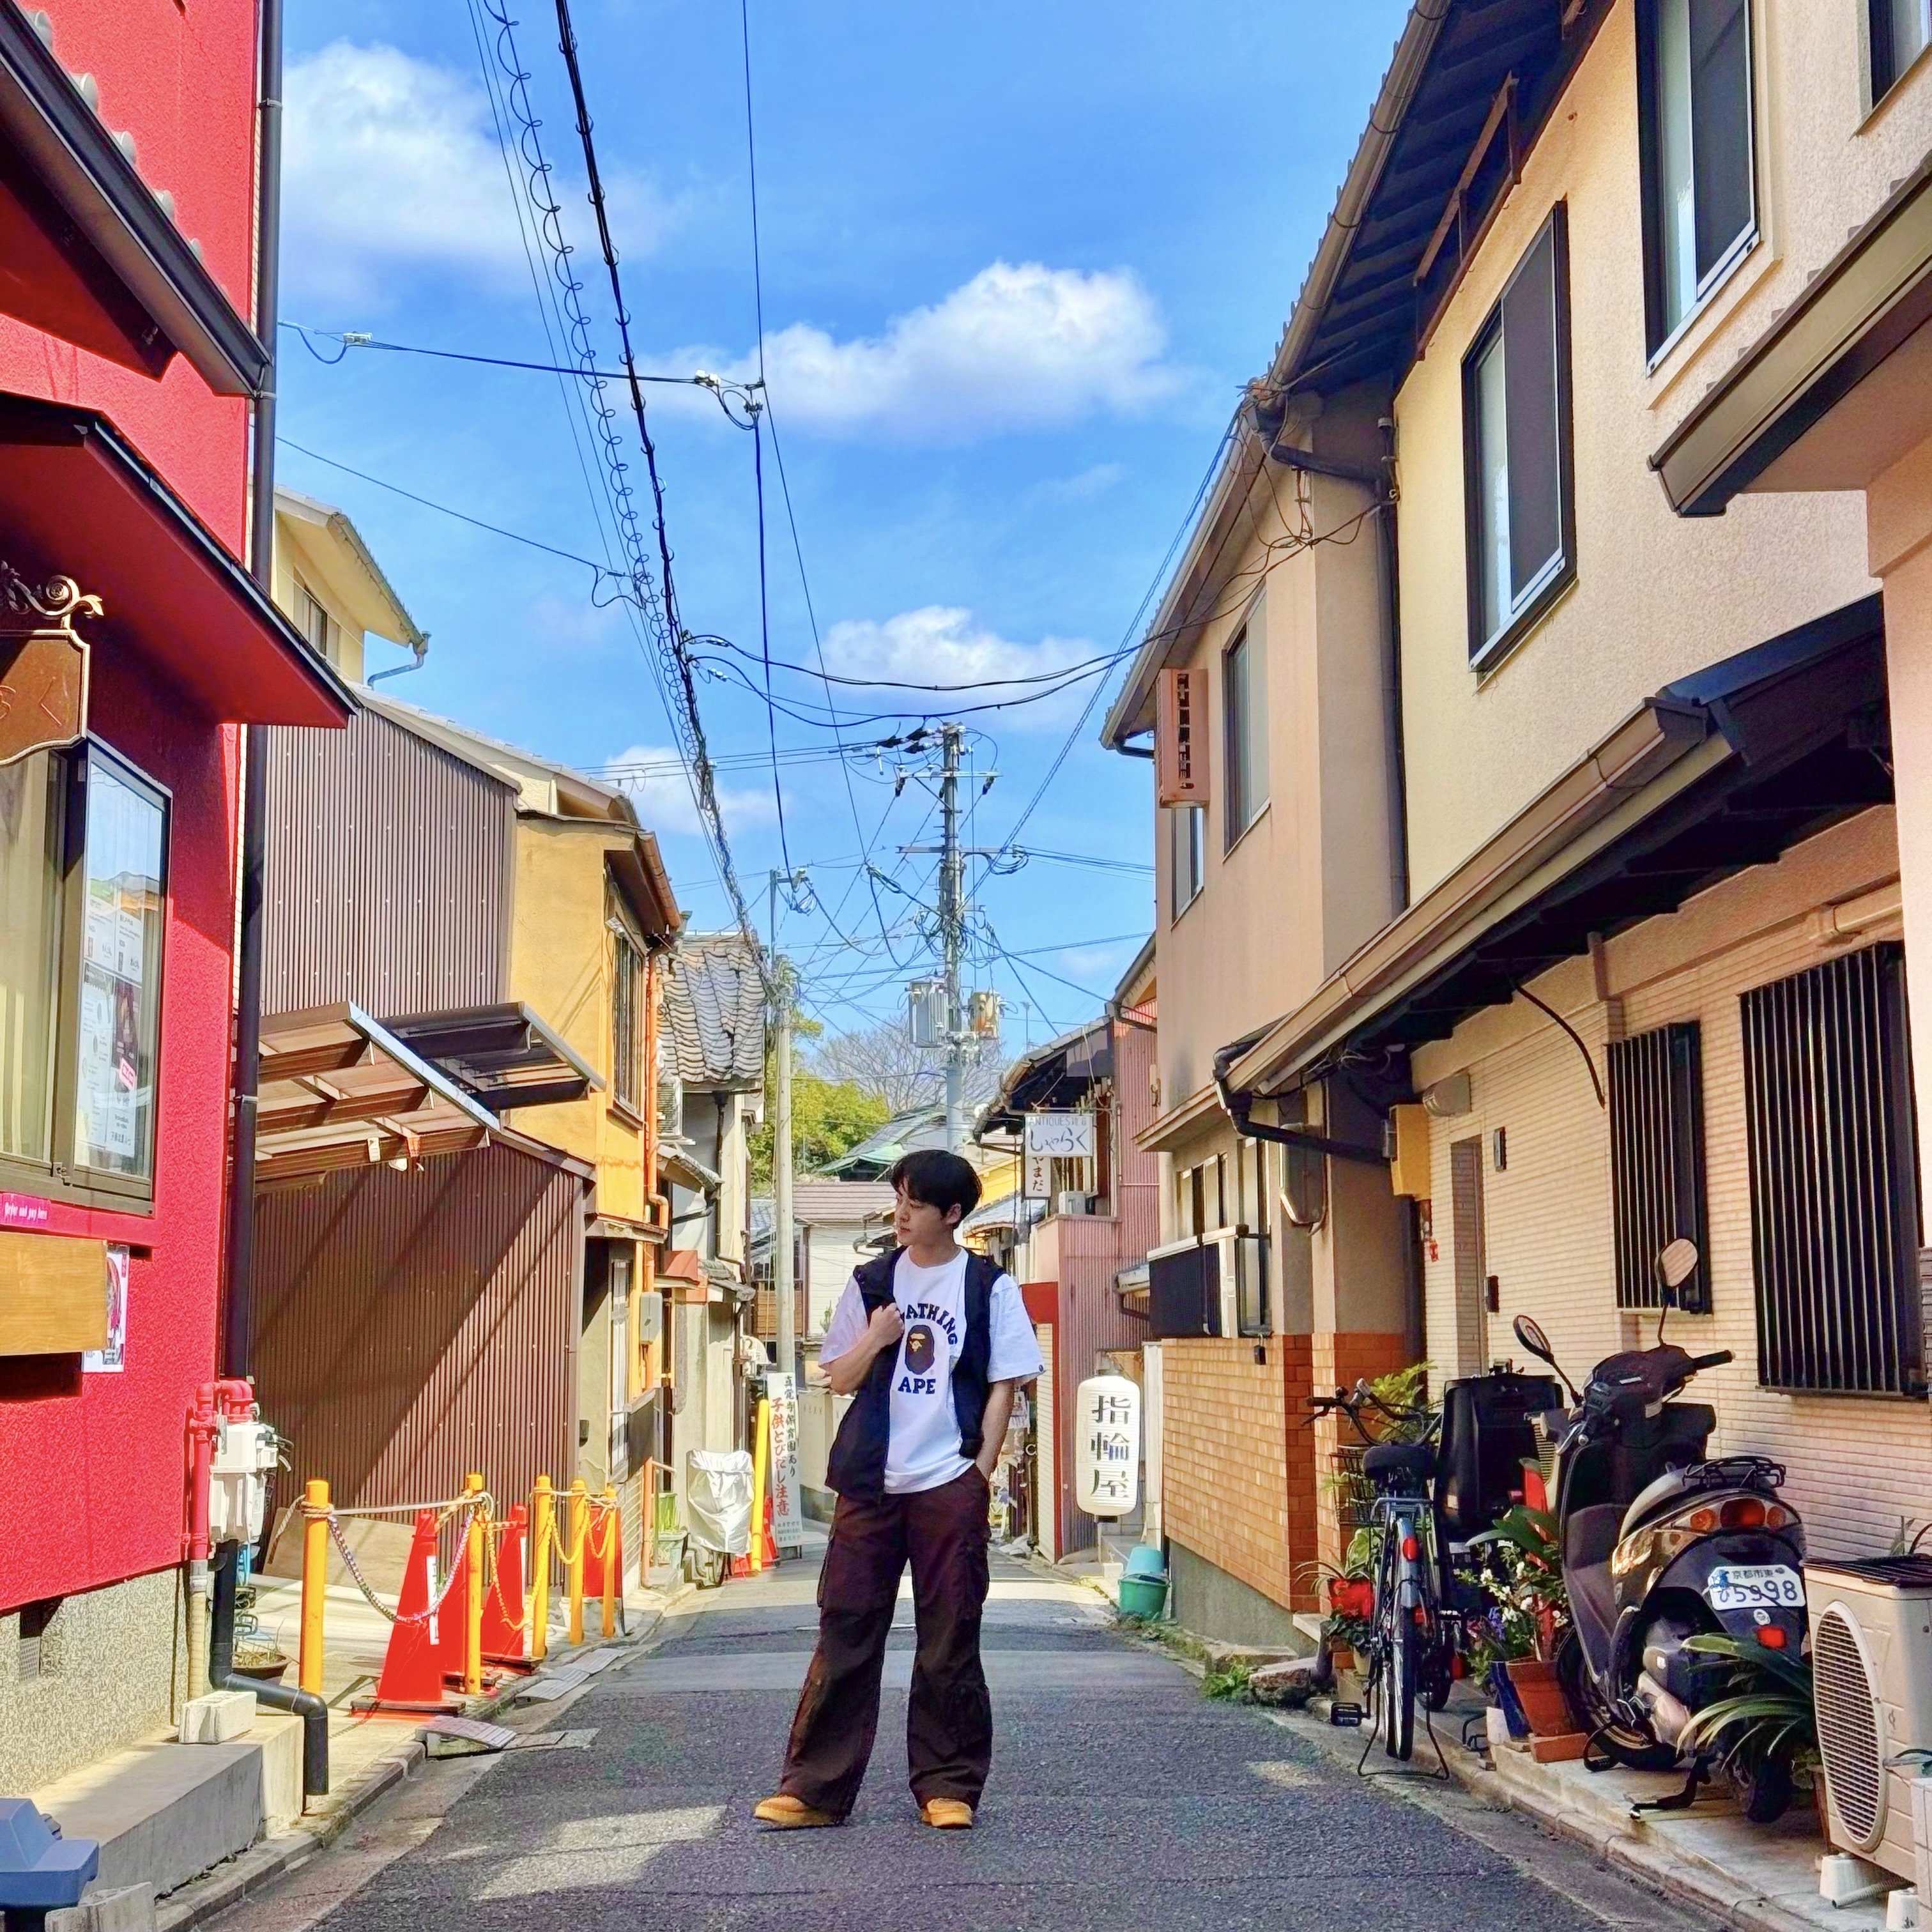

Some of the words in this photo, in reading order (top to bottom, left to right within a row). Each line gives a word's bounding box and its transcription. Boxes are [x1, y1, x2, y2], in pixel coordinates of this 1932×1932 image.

[1028, 1116, 1071, 1127] ANTIQUES
[1030, 1127, 1089, 1153] しゃらく
[901, 1303, 958, 1346] ATHING
[898, 1376, 936, 1395] APE
[770, 1397, 790, 1517] 子供とびだし注意
[1090, 1395, 1131, 1498] 指輪屋
